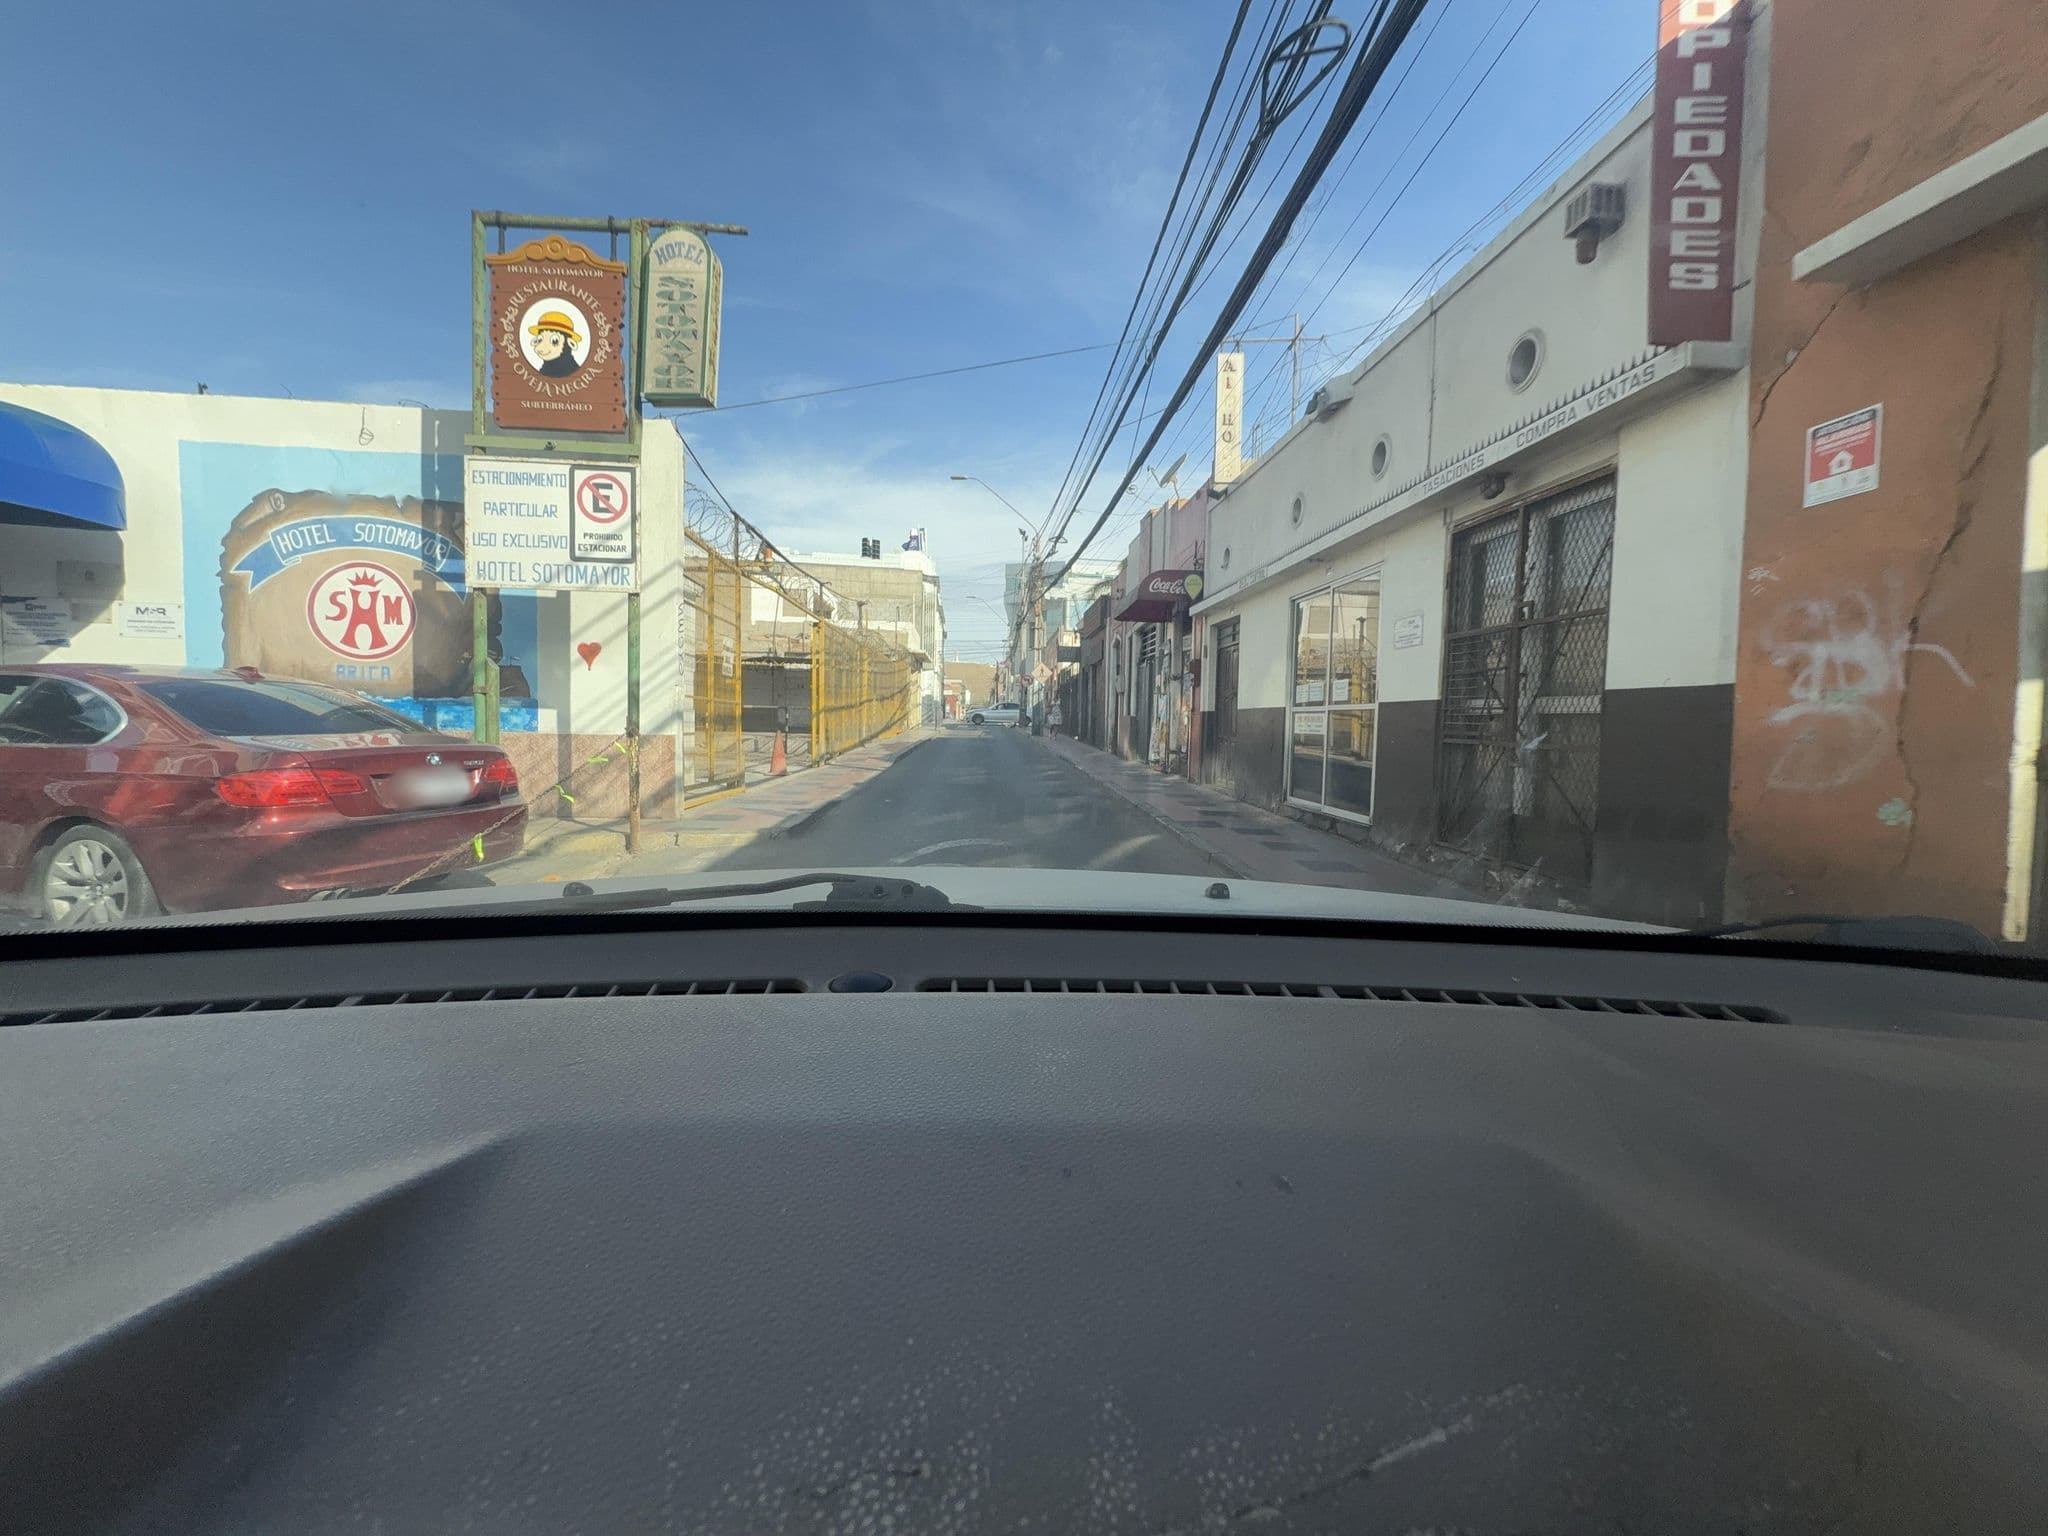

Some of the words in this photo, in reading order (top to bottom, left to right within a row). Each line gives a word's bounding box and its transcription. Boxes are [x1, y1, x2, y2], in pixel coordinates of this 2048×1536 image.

[654, 241, 705, 265] HOTEL
[507, 265, 539, 274] HOTEL
[542, 267, 604, 278] SOTOMAYOR
[509, 278, 602, 311] RESTAURANTE
[513, 362, 552, 397] OVEJA
[554, 367, 604, 397] NEGRA
[1422, 453, 1485, 495] TASACIONES
[1515, 406, 1577, 448] COMPRA
[1586, 363, 1656, 412] VENTAS
[472, 469, 567, 488] ESTACIONAMIENTO
[483, 501, 558, 518] PARTICULAR
[276, 523, 337, 555] HOTEL
[353, 522, 447, 561] SOTOMAYOR
[472, 532, 497, 547] USO
[502, 533, 568, 550] EXCLUSIVO
[583, 532, 623, 541] PROHIBIDO
[577, 543, 627, 553] ESTACIONAR
[476, 561, 527, 582] HOTEL
[532, 562, 631, 586] SOTOMAYOR
